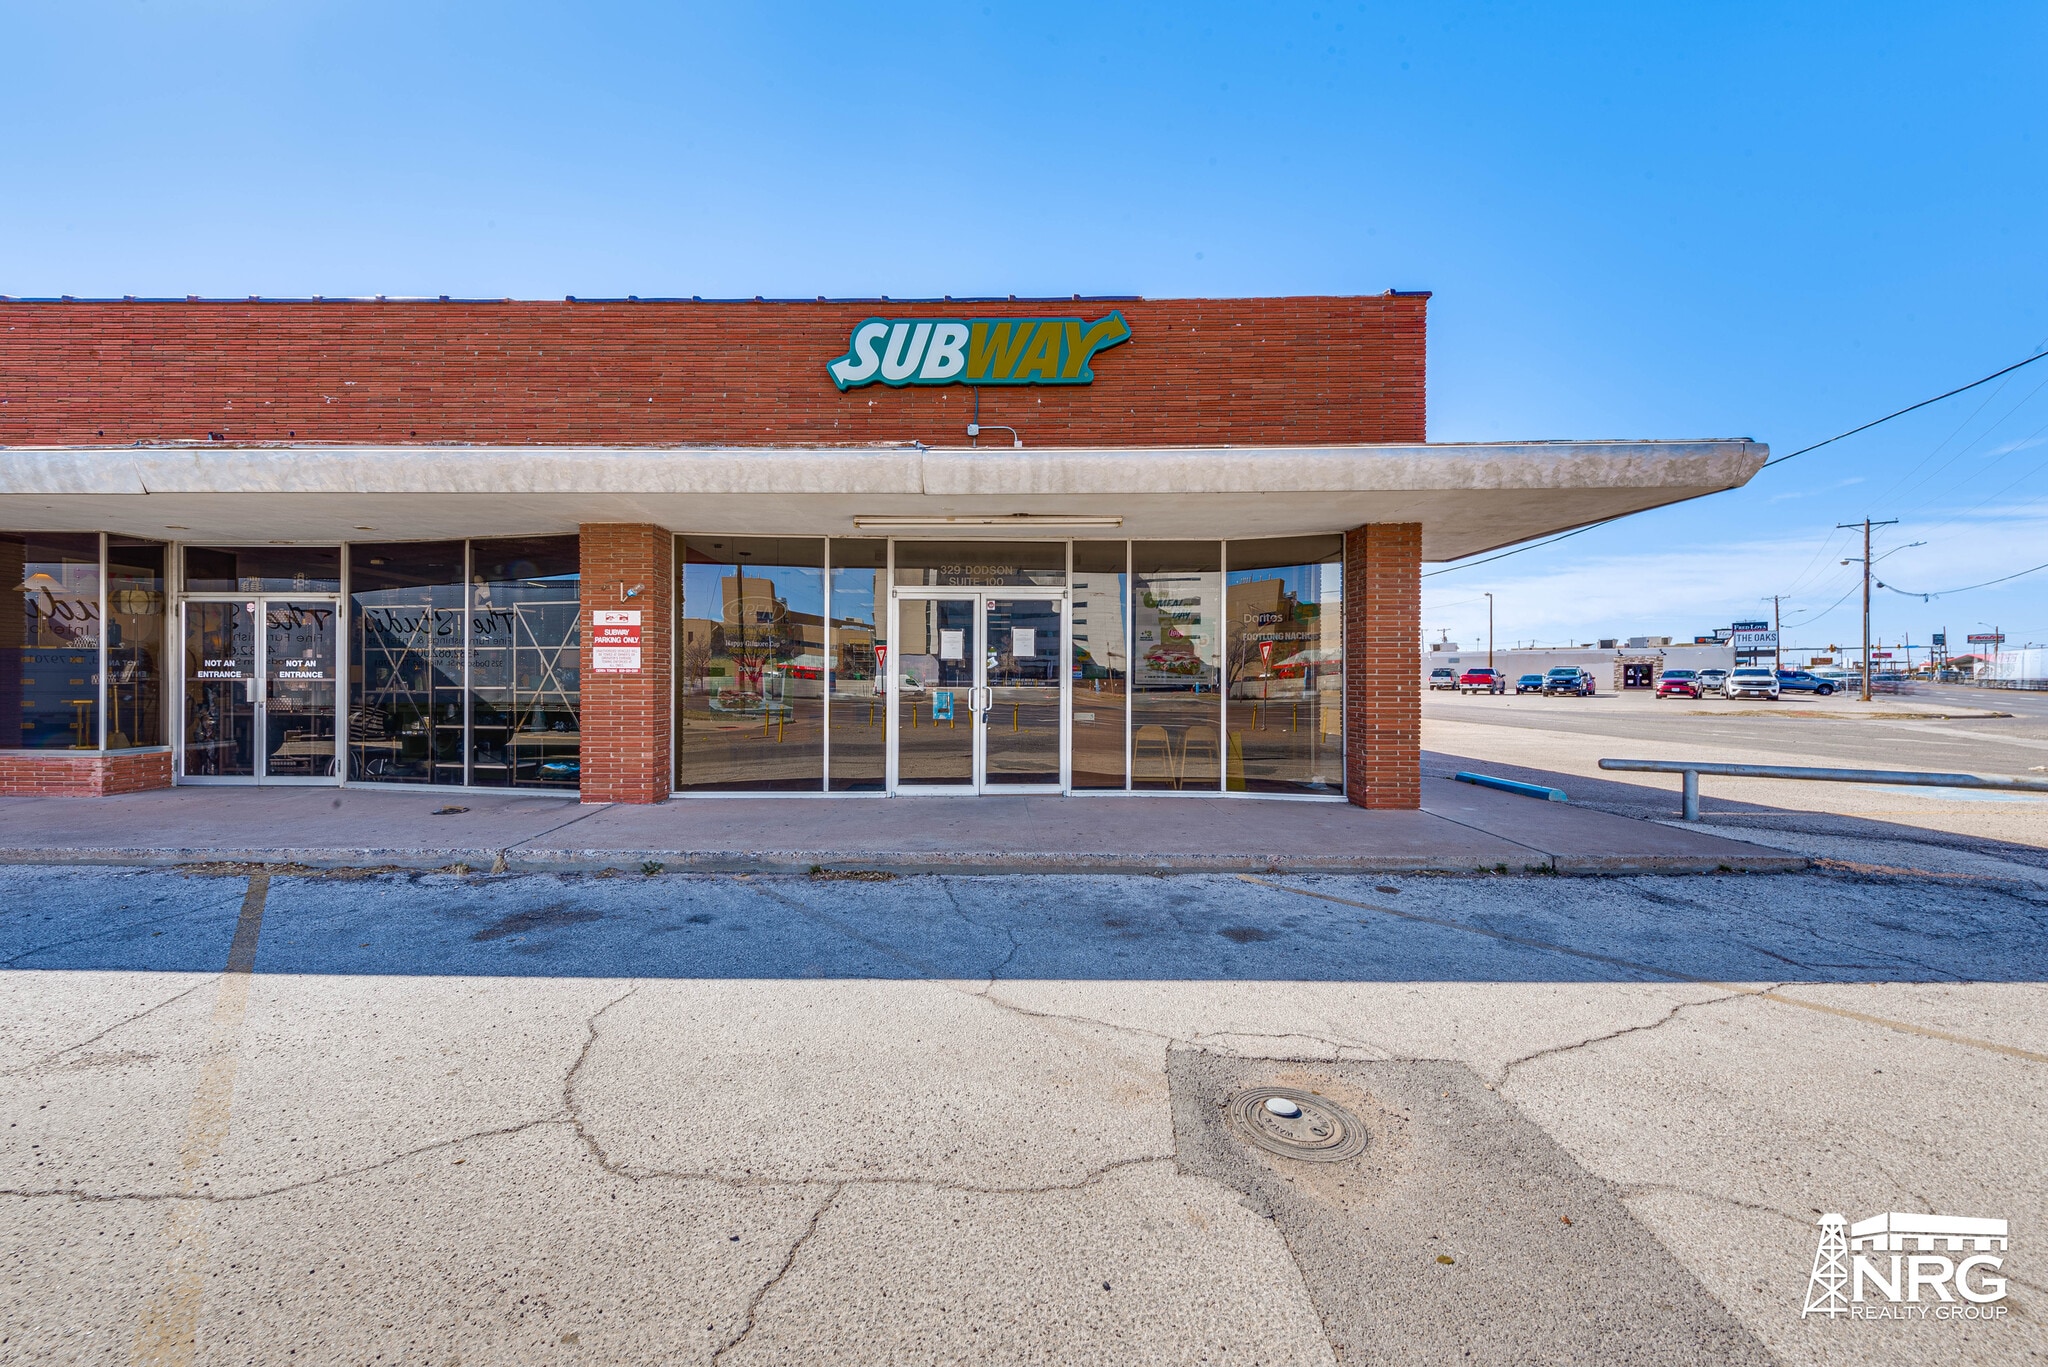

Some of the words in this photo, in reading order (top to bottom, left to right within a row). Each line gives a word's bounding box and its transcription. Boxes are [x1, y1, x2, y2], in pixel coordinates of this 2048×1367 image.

[831, 314, 1126, 385] SUBWAY
[940, 565, 961, 575] 329
[965, 565, 1013, 575] DODSON
[949, 577, 980, 586] SUITE
[986, 577, 1004, 586] 100
[1243, 613, 1283, 623] Doritos
[604, 628, 630, 636] SUBWAY
[594, 636, 622, 644] PARKING
[1736, 633, 1752, 642] THE
[1754, 633, 1777, 642] OAKS
[204, 659, 221, 667] NOT
[223, 659, 236, 667] AN
[285, 659, 302, 667] NOT
[304, 659, 317, 667] AN
[197, 671, 242, 679] ENTRANCE
[279, 671, 323, 679] ENTRANCE
